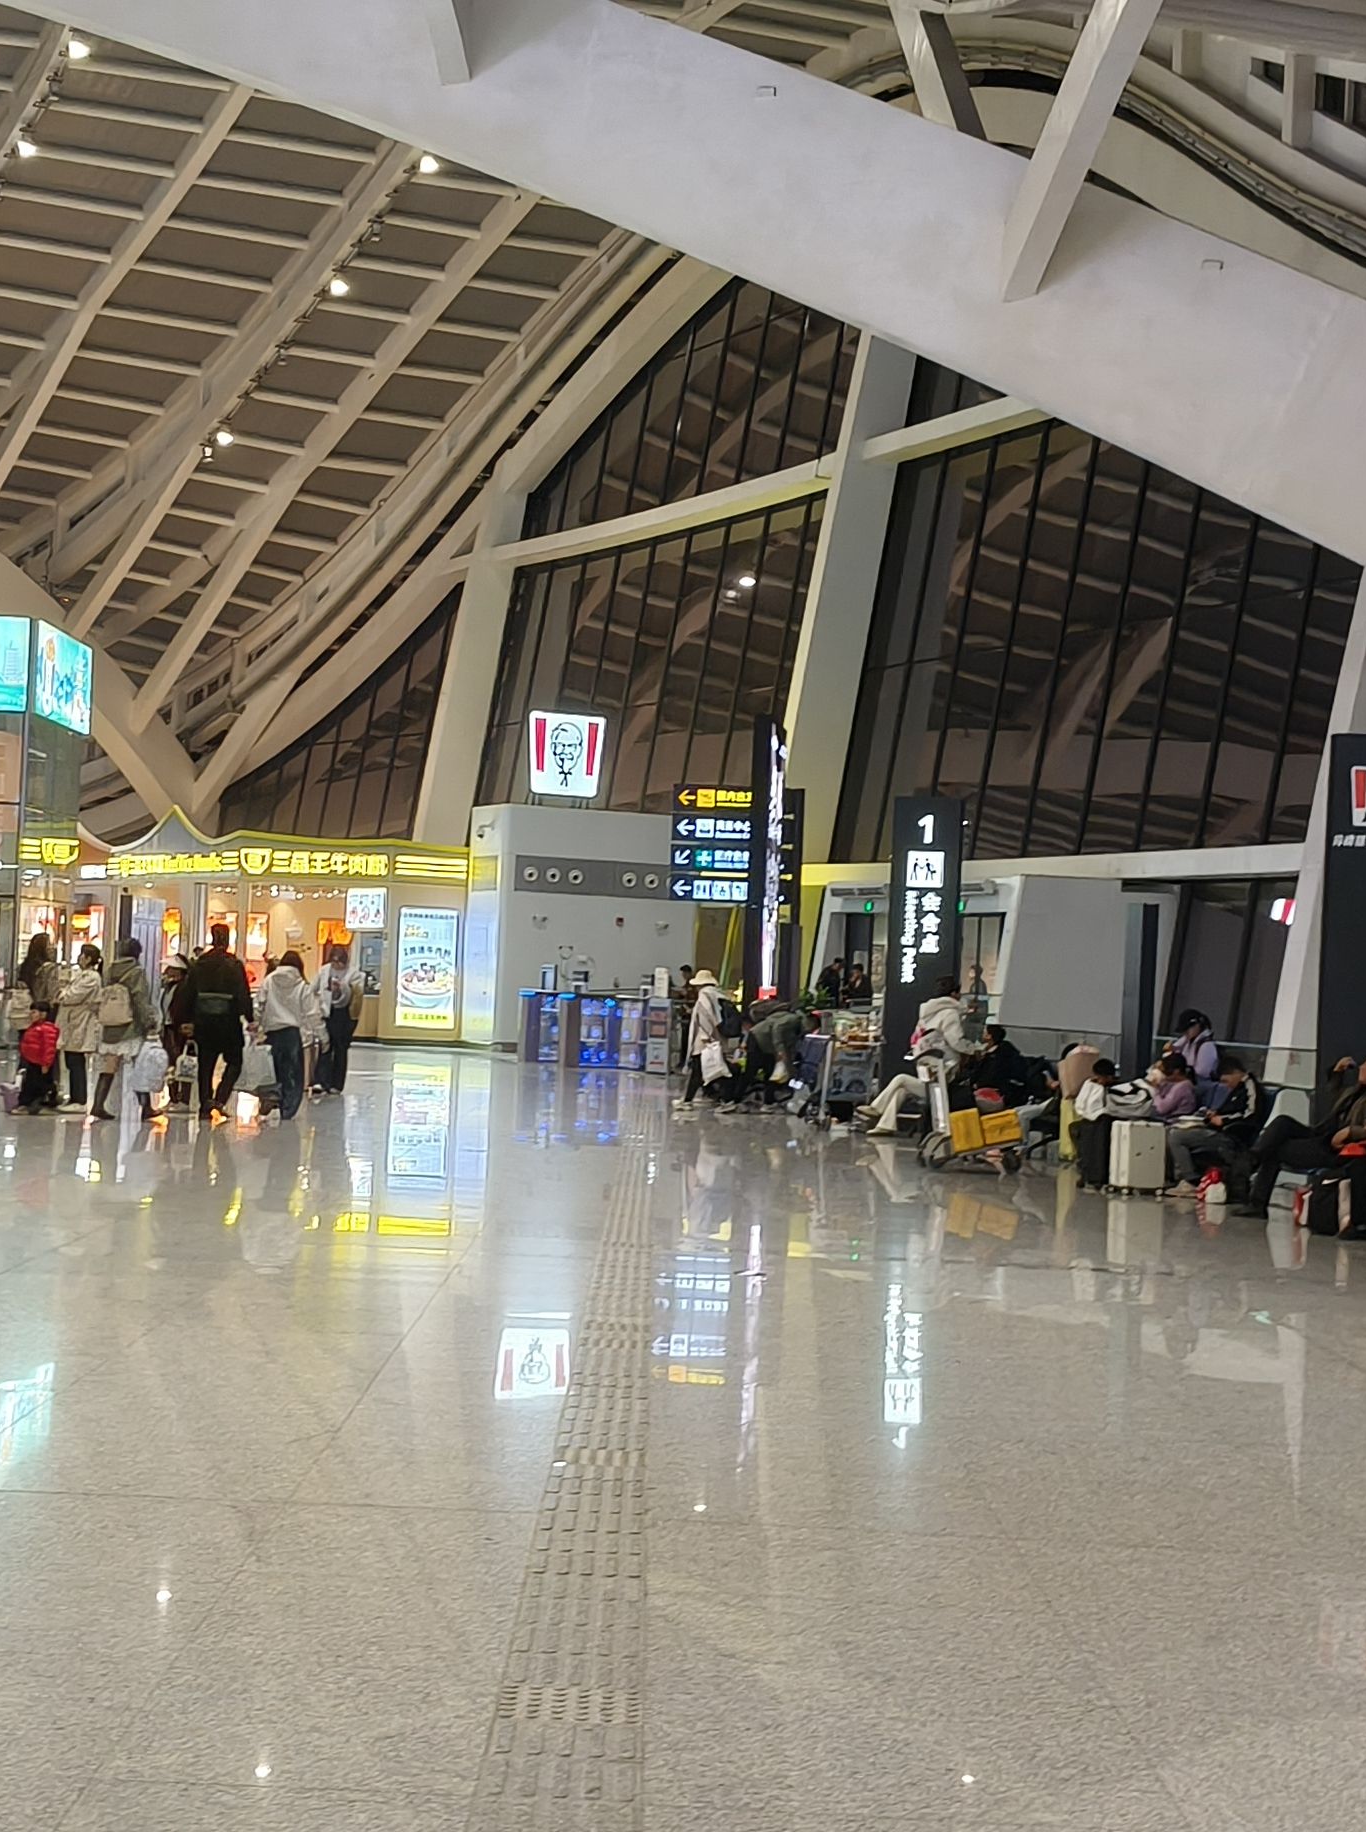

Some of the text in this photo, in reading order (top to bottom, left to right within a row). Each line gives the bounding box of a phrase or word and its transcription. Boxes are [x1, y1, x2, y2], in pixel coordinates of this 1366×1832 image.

[917, 814, 935, 844] 1
[918, 891, 943, 954] 会合点
